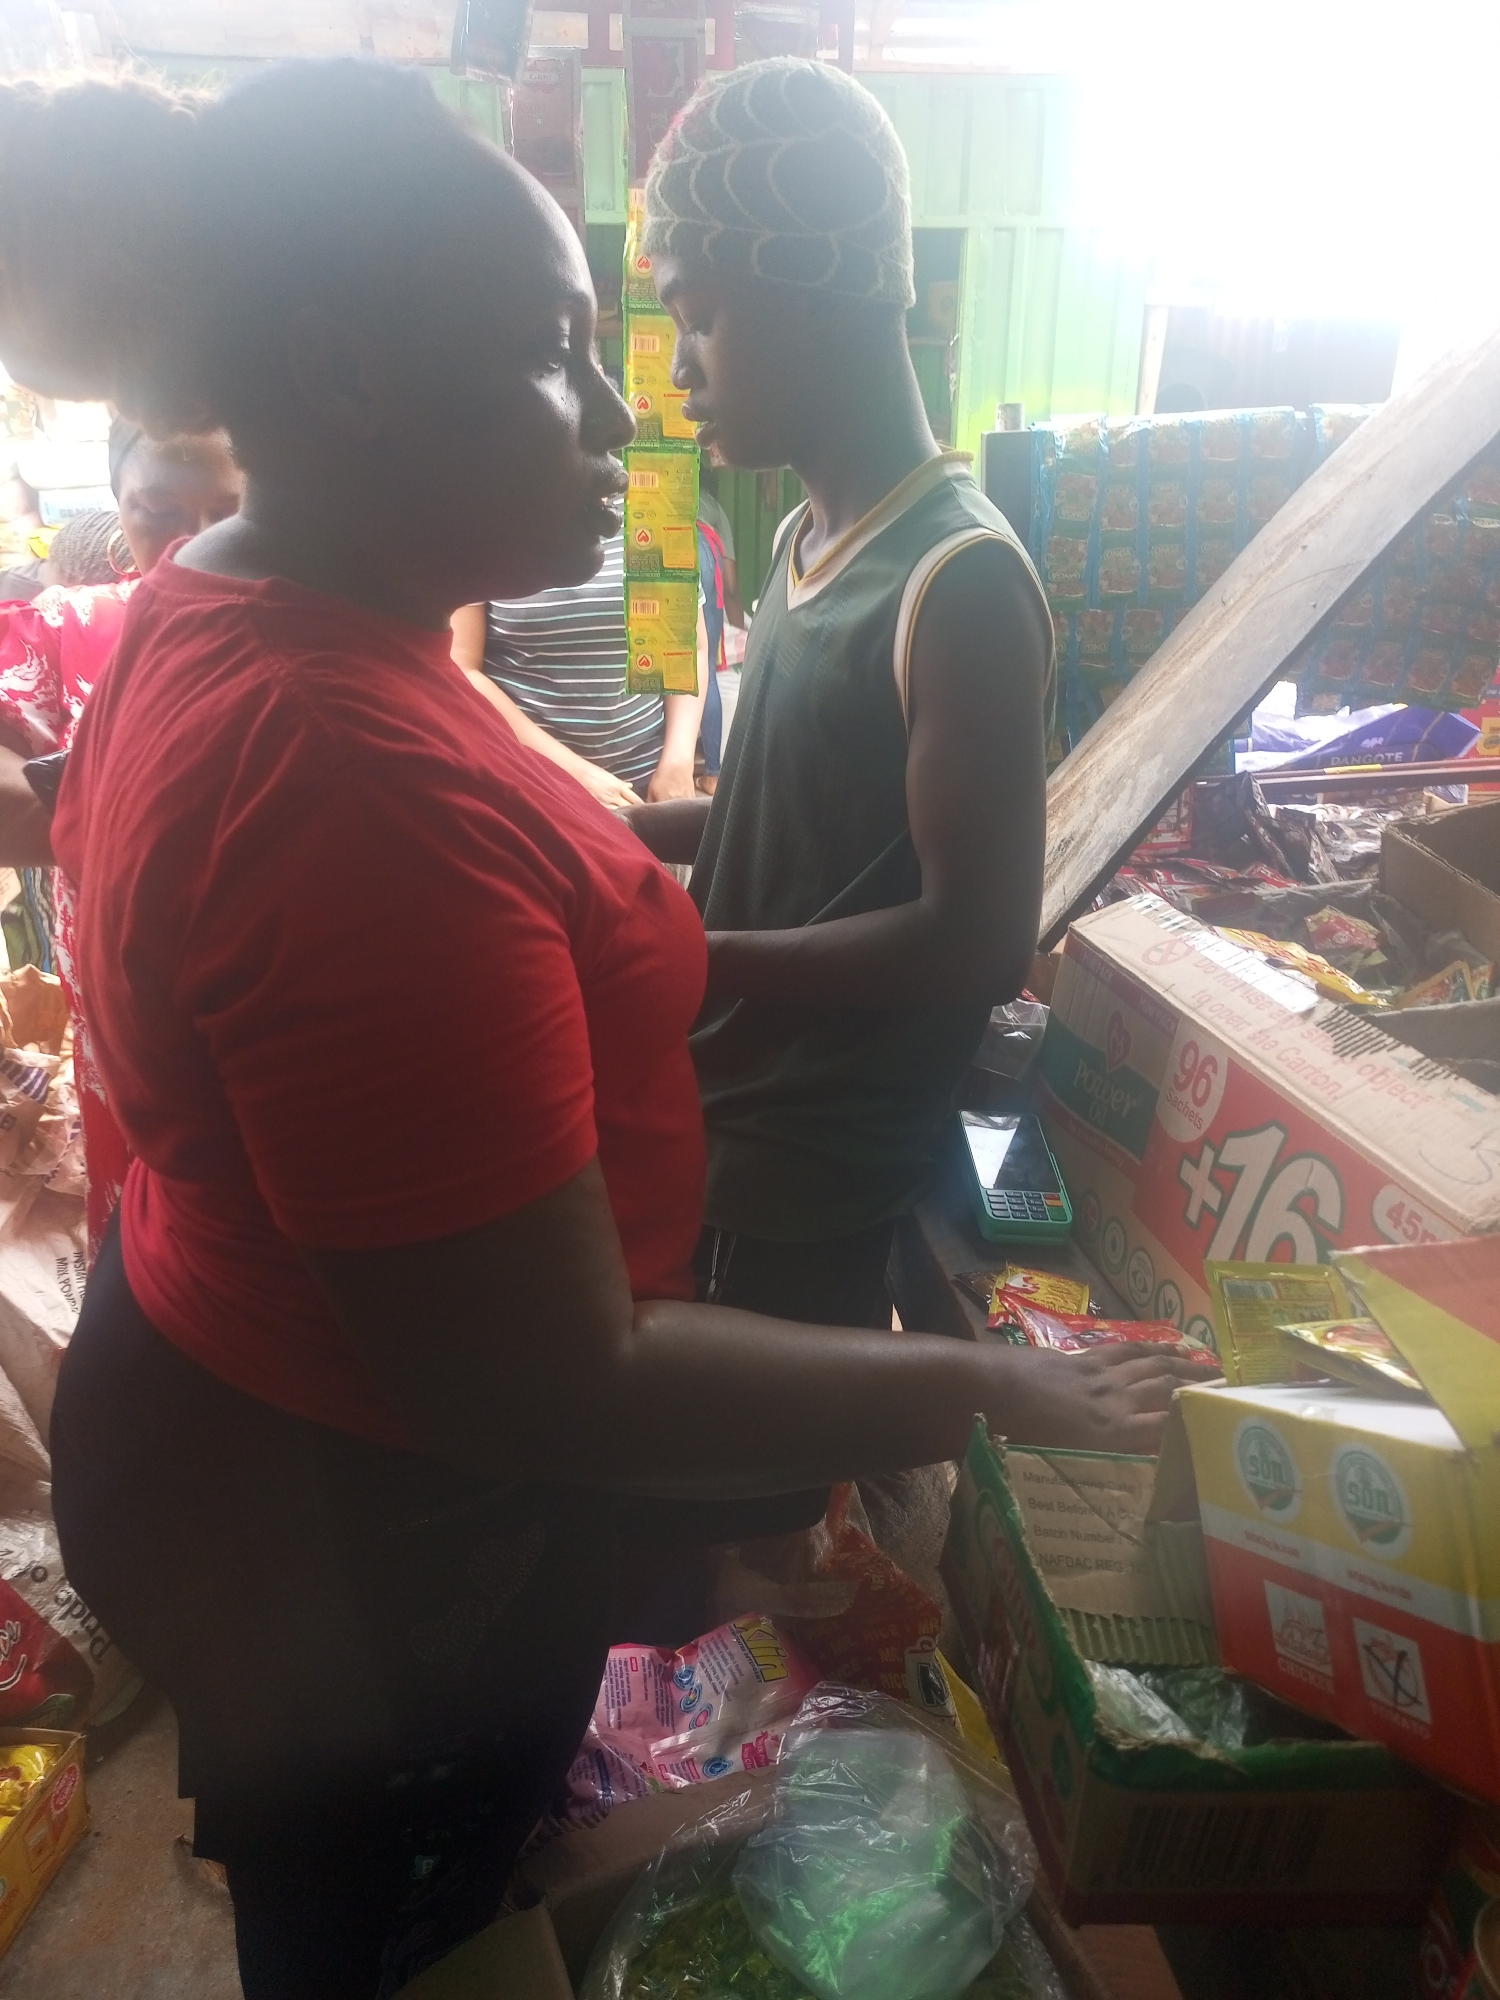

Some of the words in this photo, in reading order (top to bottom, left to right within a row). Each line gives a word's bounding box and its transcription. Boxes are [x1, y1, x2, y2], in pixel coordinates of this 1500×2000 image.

[529, 72, 552, 81] Gino
[1105, 548, 1133, 559] ONGA
[1330, 751, 1404, 766] DANGOTE
[1207, 1000, 1253, 1033] open
[1276, 1046, 1344, 1101] Carton.
[1242, 987, 1274, 1011] use
[1357, 1061, 1437, 1110] object
[1073, 1057, 1139, 1118] Power
[1173, 1040, 1218, 1108] 96
[1166, 1088, 1204, 1131] Sachets
[1178, 1120, 1345, 1264] +16
[1028, 1498, 1056, 1512] Best
[1033, 1525, 1069, 1540] Batch
[1070, 1529, 1116, 1545] Number
[1038, 1554, 1093, 1571] NAFDAC
[734, 1617, 789, 1682] Klin
[743, 1651, 763, 1683] DETERGENT
